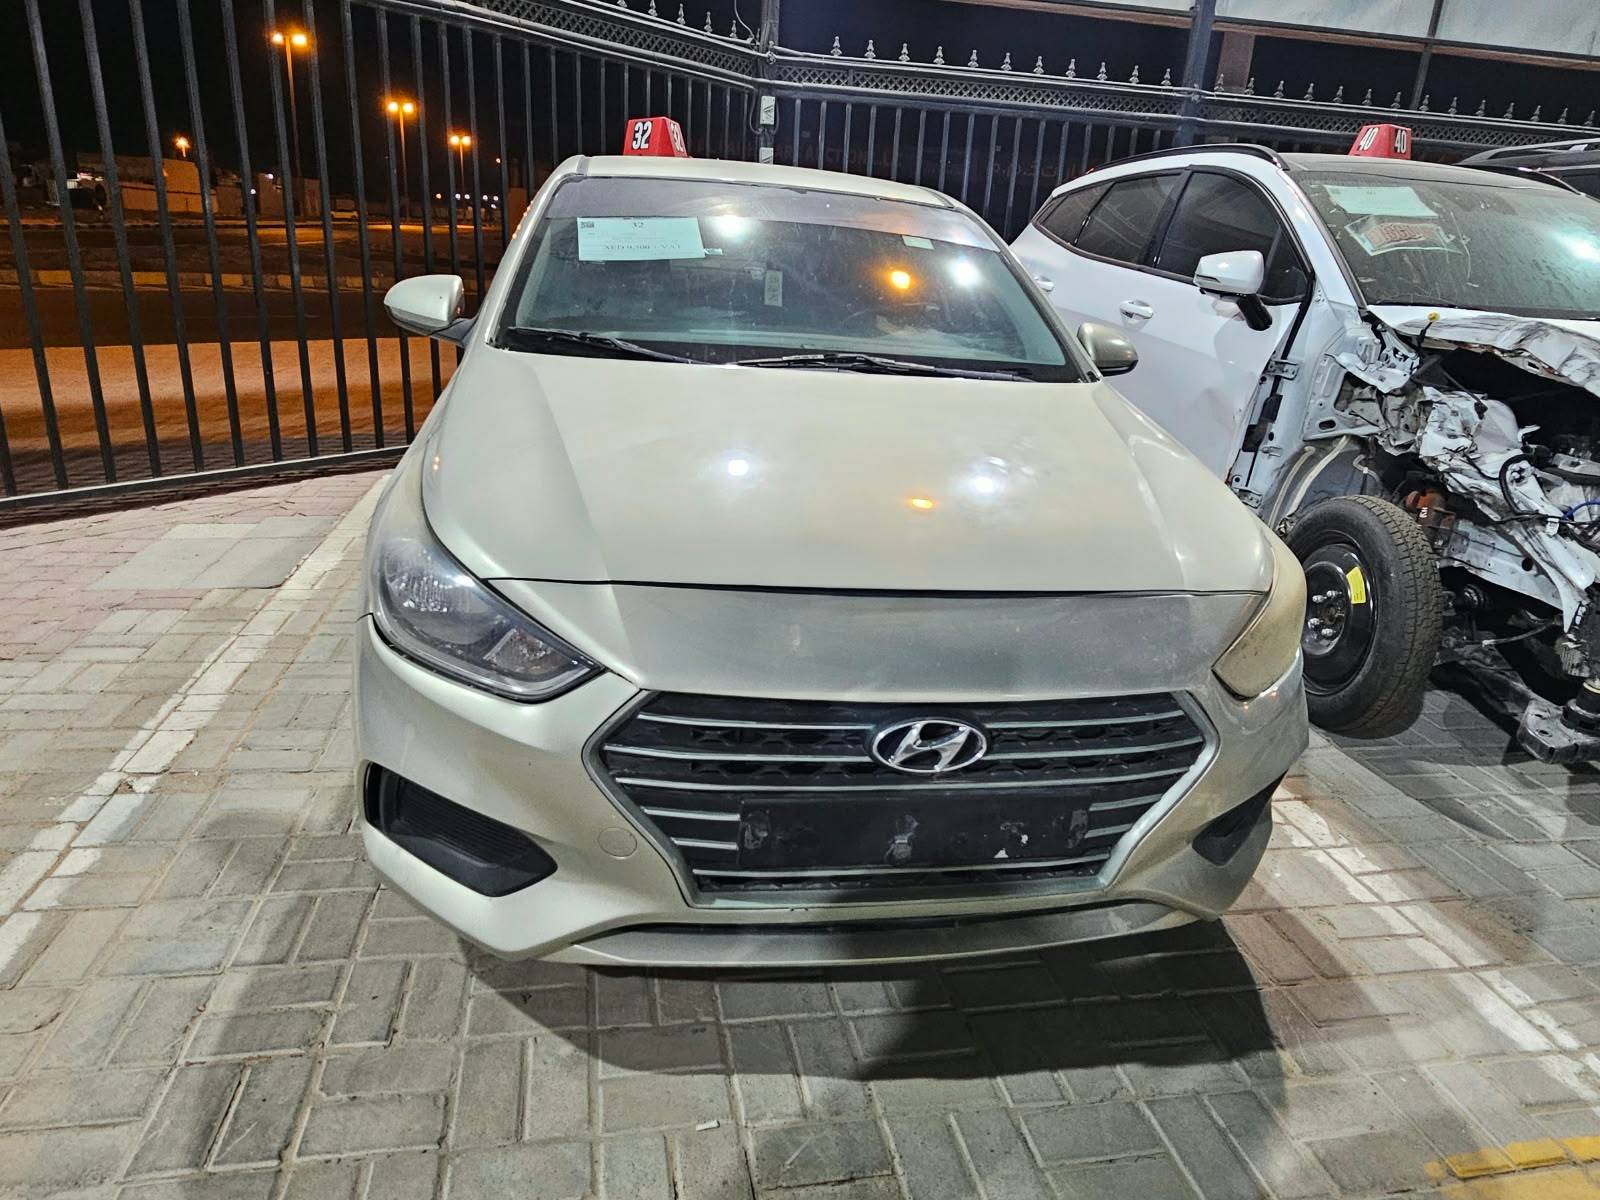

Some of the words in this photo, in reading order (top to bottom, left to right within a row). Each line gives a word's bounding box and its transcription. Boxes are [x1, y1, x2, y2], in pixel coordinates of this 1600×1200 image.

[632, 121, 653, 150] 32
[1358, 127, 1379, 151] 40
[1394, 128, 1407, 154] 40
